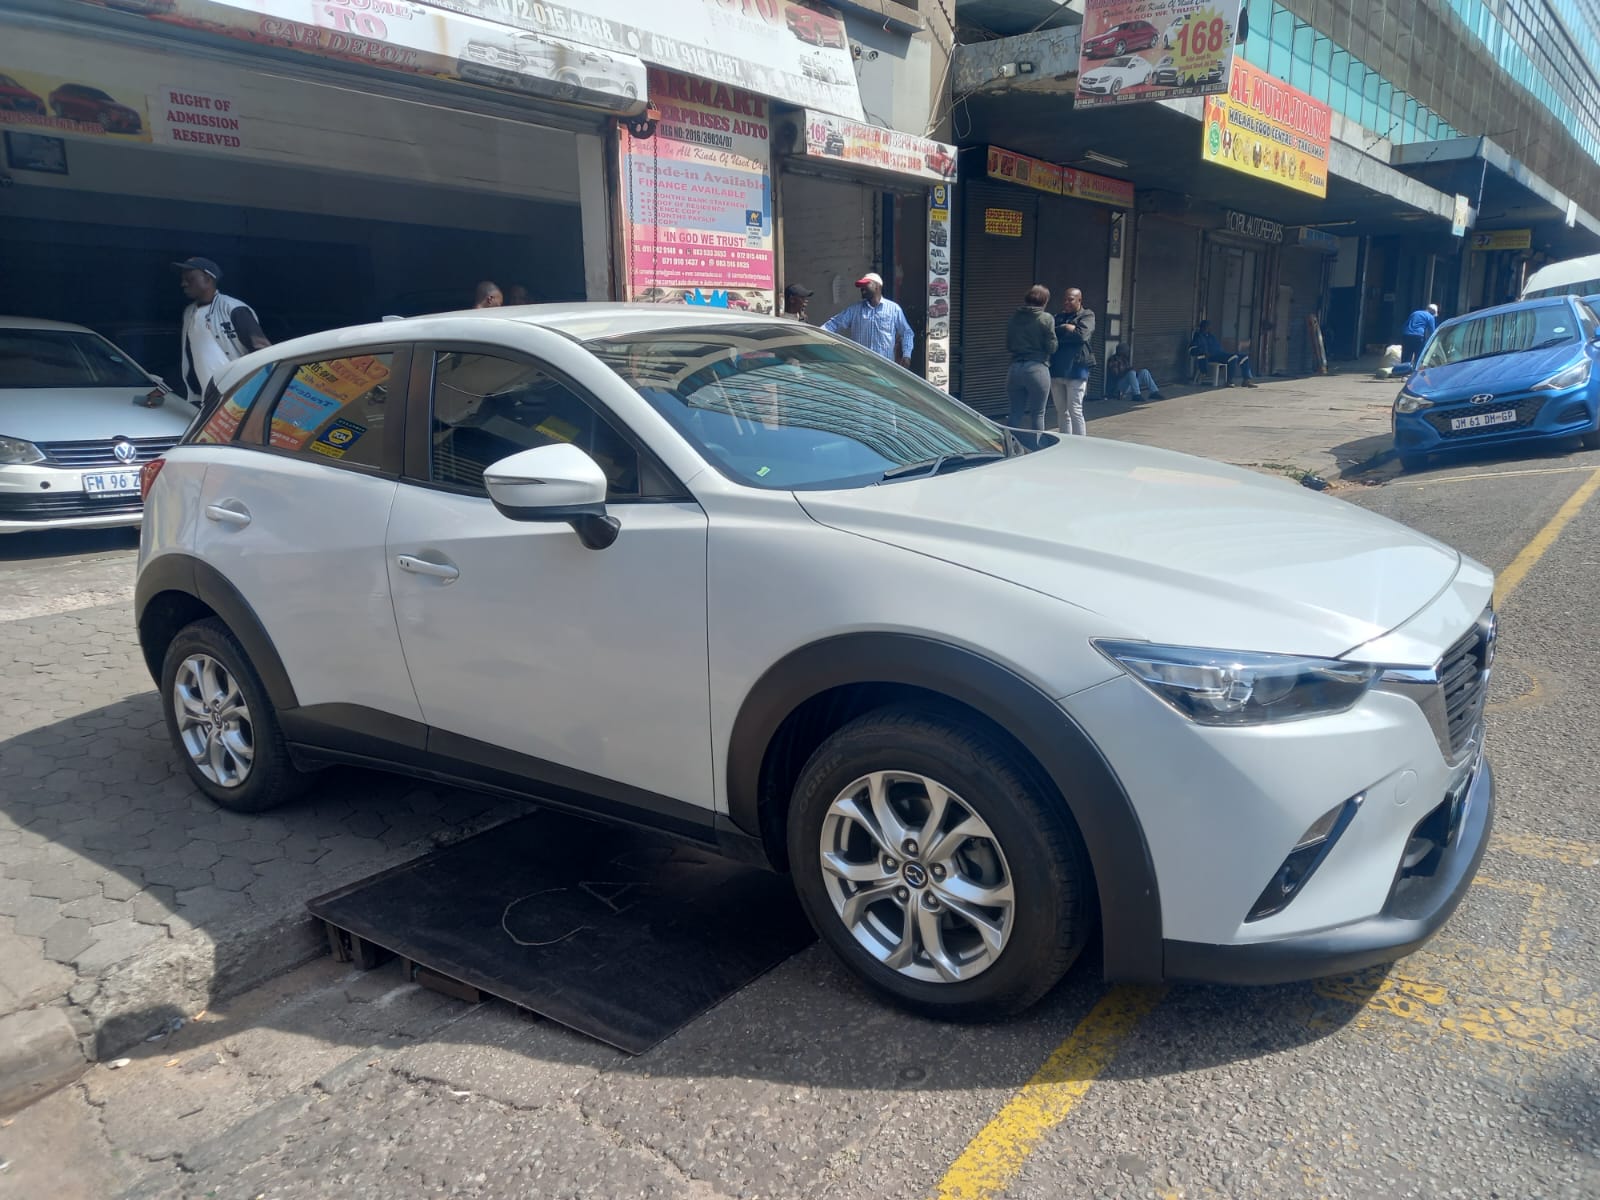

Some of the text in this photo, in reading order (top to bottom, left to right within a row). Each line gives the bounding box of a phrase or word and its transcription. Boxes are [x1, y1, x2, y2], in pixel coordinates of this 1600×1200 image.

[1172, 5, 1202, 15] TRUST
[325, 4, 388, 40] TO
[260, 18, 417, 66] CAR DEPOT
[1177, 17, 1224, 57] 168
[650, 68, 768, 119] ARMART
[1230, 64, 1250, 107] AL
[169, 91, 231, 112] RIGHT OF
[166, 110, 239, 130] ADMISSION
[660, 104, 768, 141] ERPRISES AUTO
[1256, 118, 1271, 138] FOOD
[172, 128, 241, 148] RESERVED
[810, 121, 827, 143] 168
[693, 148, 718, 163] Kinds
[634, 160, 766, 190] Trade-in Available
[639, 177, 747, 199] FINANCE AVAILABLE
[647, 198, 673, 207] POOF
[679, 232, 698, 243] GOD
[701, 233, 714, 245] WE
[1455, 417, 1467, 429] JM
[1469, 415, 1480, 427] 61
[86, 476, 105, 492] FM
[111, 474, 128, 489] 96
